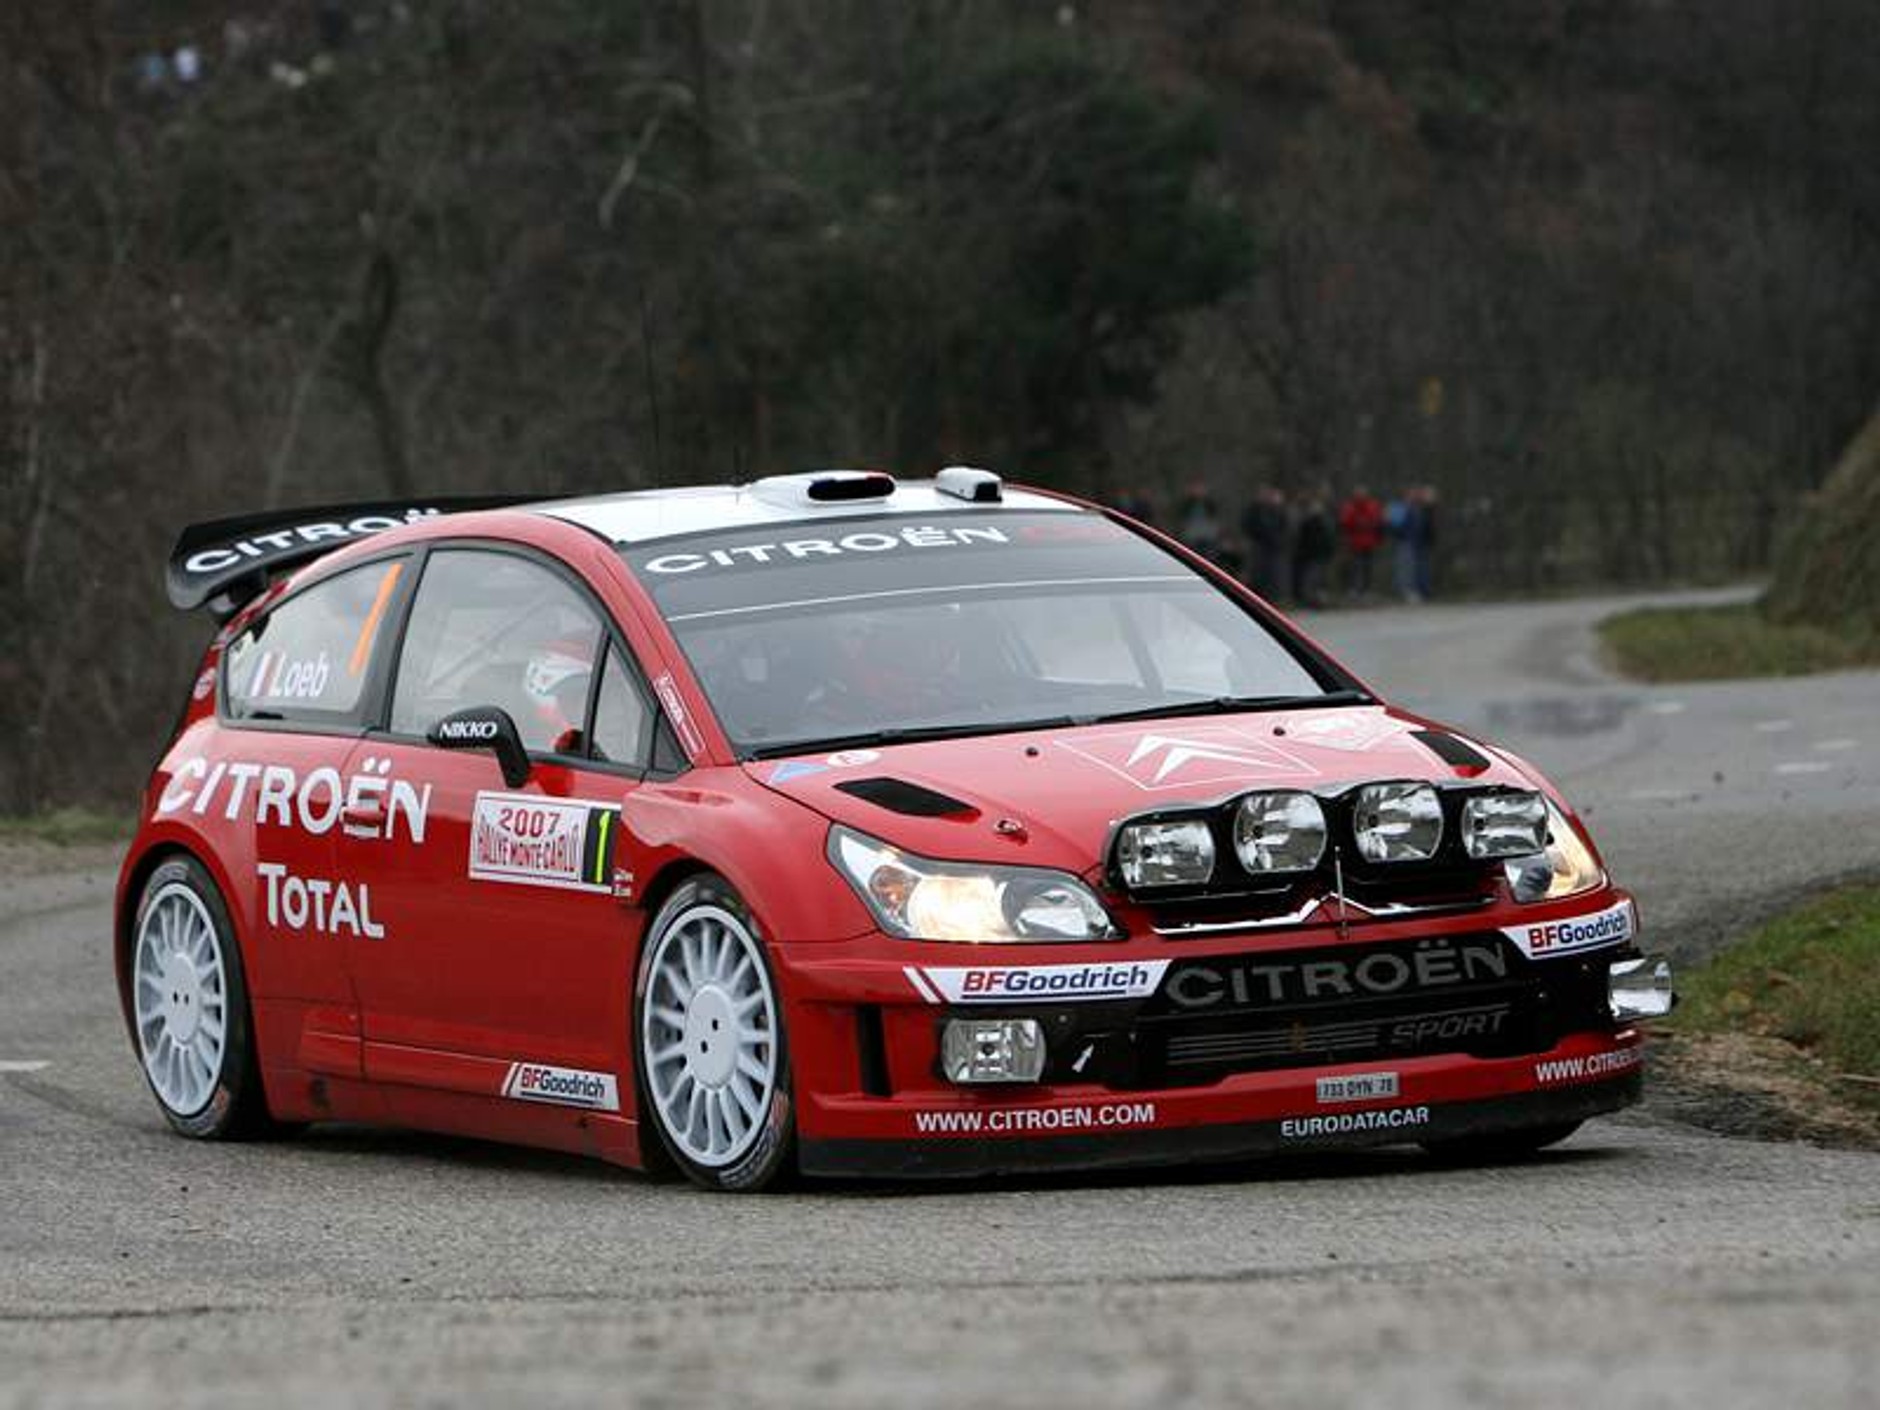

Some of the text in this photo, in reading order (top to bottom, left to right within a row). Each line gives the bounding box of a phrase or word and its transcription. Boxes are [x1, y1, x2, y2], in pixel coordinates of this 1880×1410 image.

[645, 526, 1009, 573] CITROËN
[269, 652, 329, 697] Loeb
[439, 720, 498, 739] NIKKO
[158, 755, 432, 843] CITROËN
[479, 813, 509, 866] RALLYE
[499, 808, 560, 837] 2007
[596, 810, 611, 883] 1
[1529, 910, 1628, 949] BFGoodrich
[963, 965, 1149, 993] BFGoodrich
[1166, 939, 1506, 1005] CITROËN
[1391, 1010, 1510, 1047] SPORT
[521, 1067, 606, 1097] BFGoodrich
[915, 1103, 1156, 1132] WWW.CITROEN.COM
[1280, 1106, 1430, 1137] EURODATACAR
